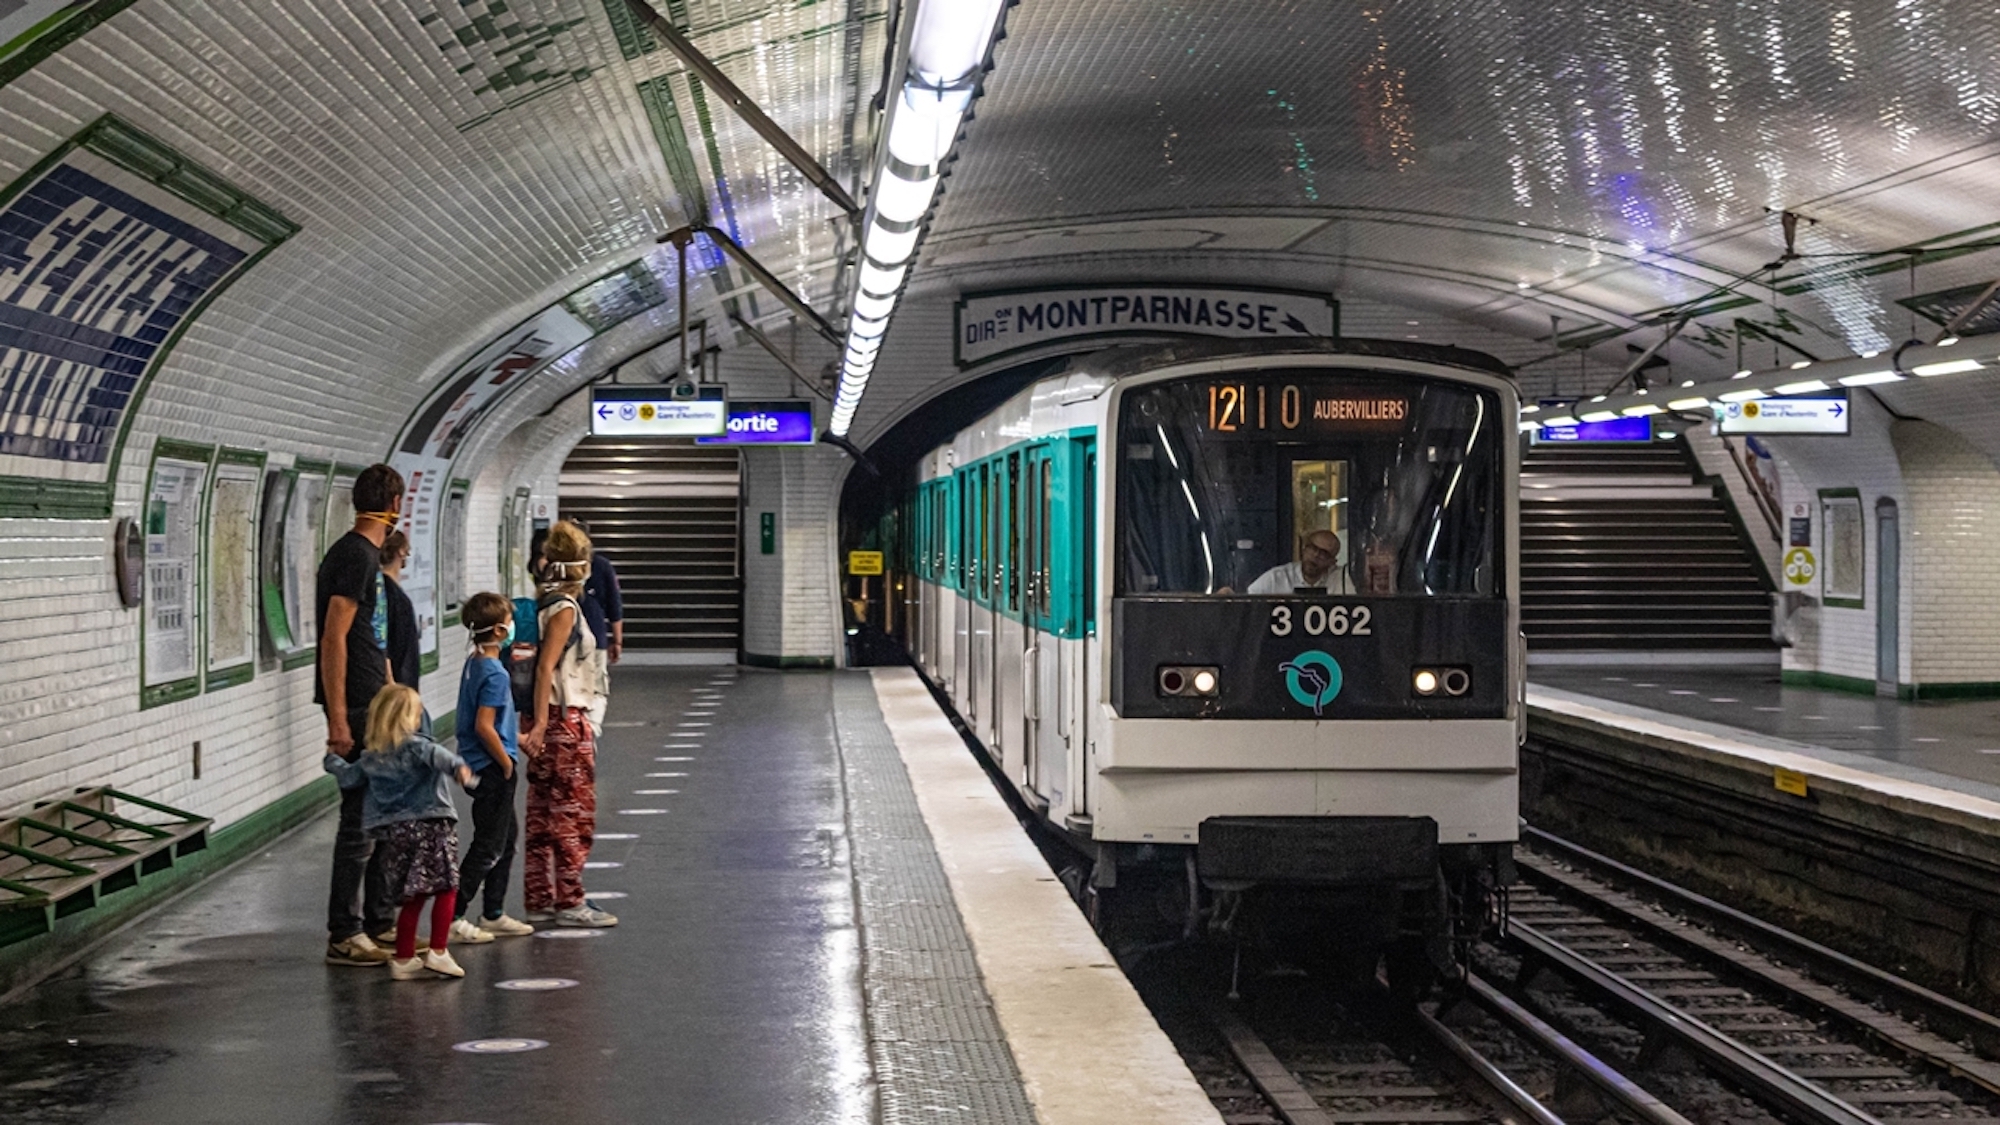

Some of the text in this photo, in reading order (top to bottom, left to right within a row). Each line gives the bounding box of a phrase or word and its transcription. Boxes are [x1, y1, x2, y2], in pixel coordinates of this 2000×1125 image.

[0, 196, 210, 338] SEVRES
[1017, 296, 1278, 333] MONTPARNASSE
[1313, 400, 1404, 420] AUBERVILLIERS
[1270, 605, 1372, 636] 3 062
